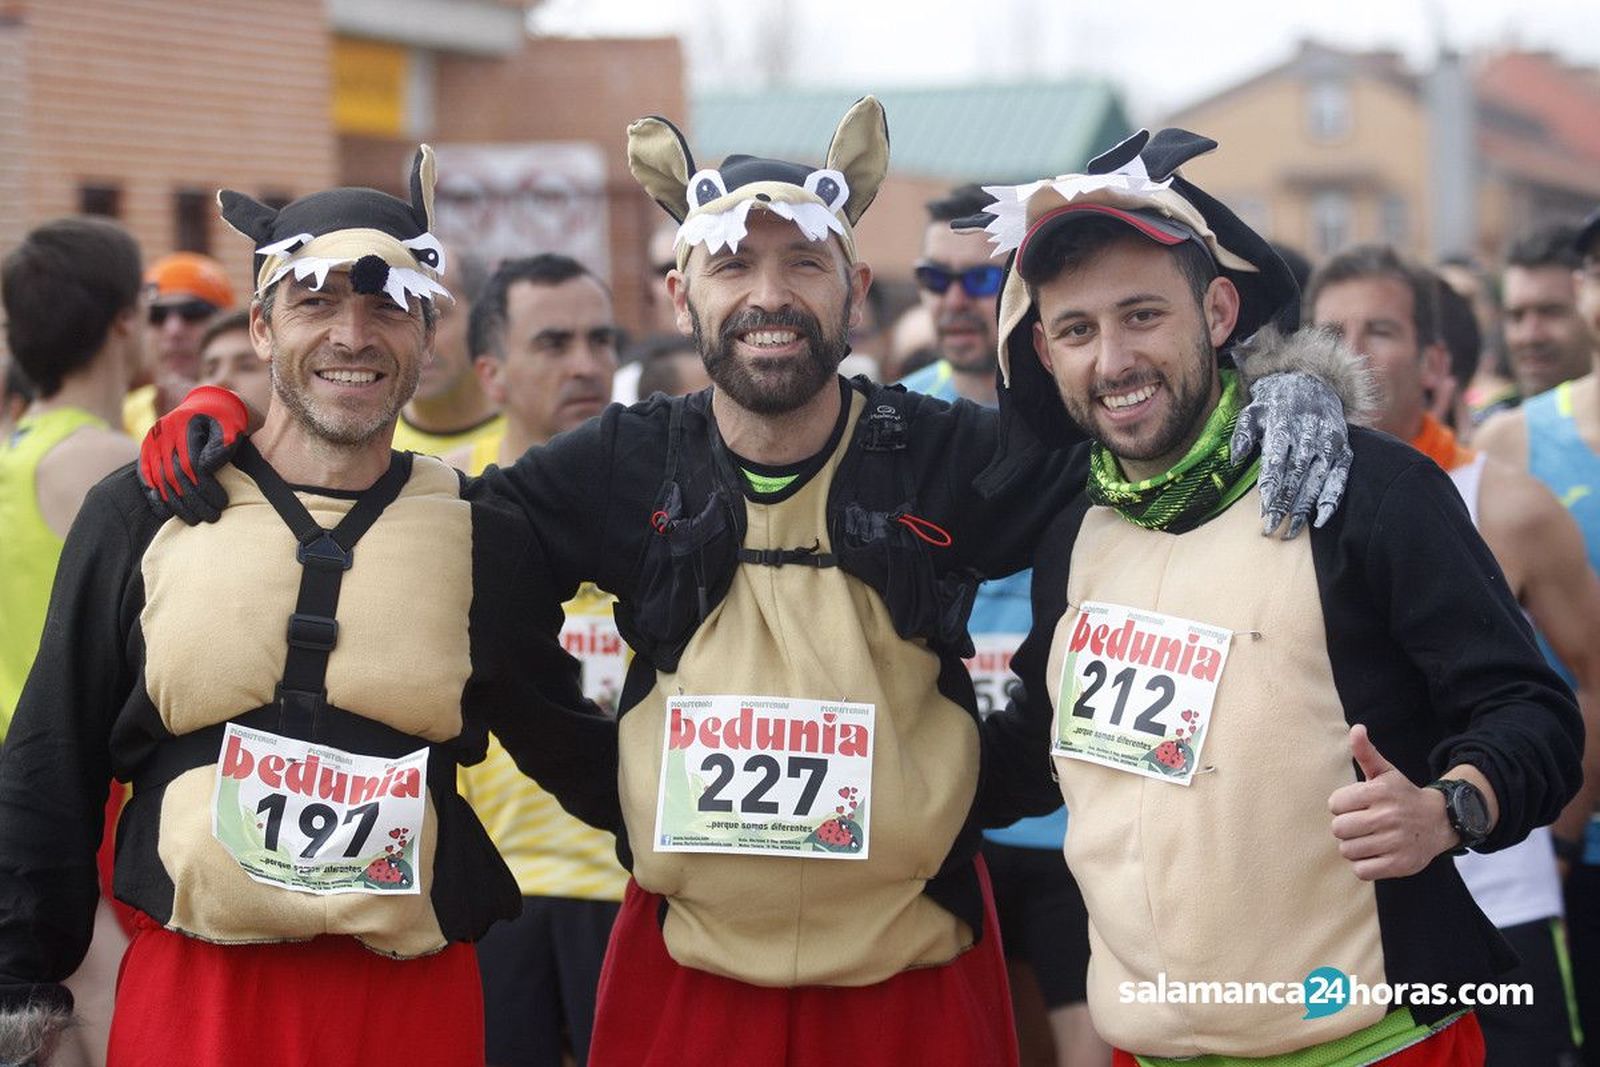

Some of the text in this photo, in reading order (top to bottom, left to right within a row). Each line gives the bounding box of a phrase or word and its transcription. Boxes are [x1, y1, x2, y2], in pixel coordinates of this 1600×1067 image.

[1069, 613, 1222, 683] bedunia
[1072, 660, 1176, 737] 212
[669, 708, 869, 758] bedunia
[1117, 735, 1151, 751] diferentes
[222, 735, 421, 806] bedunia
[697, 753, 829, 816] 227
[256, 793, 380, 859] 197
[741, 822, 769, 830] somos
[770, 822, 813, 833] diferentes
